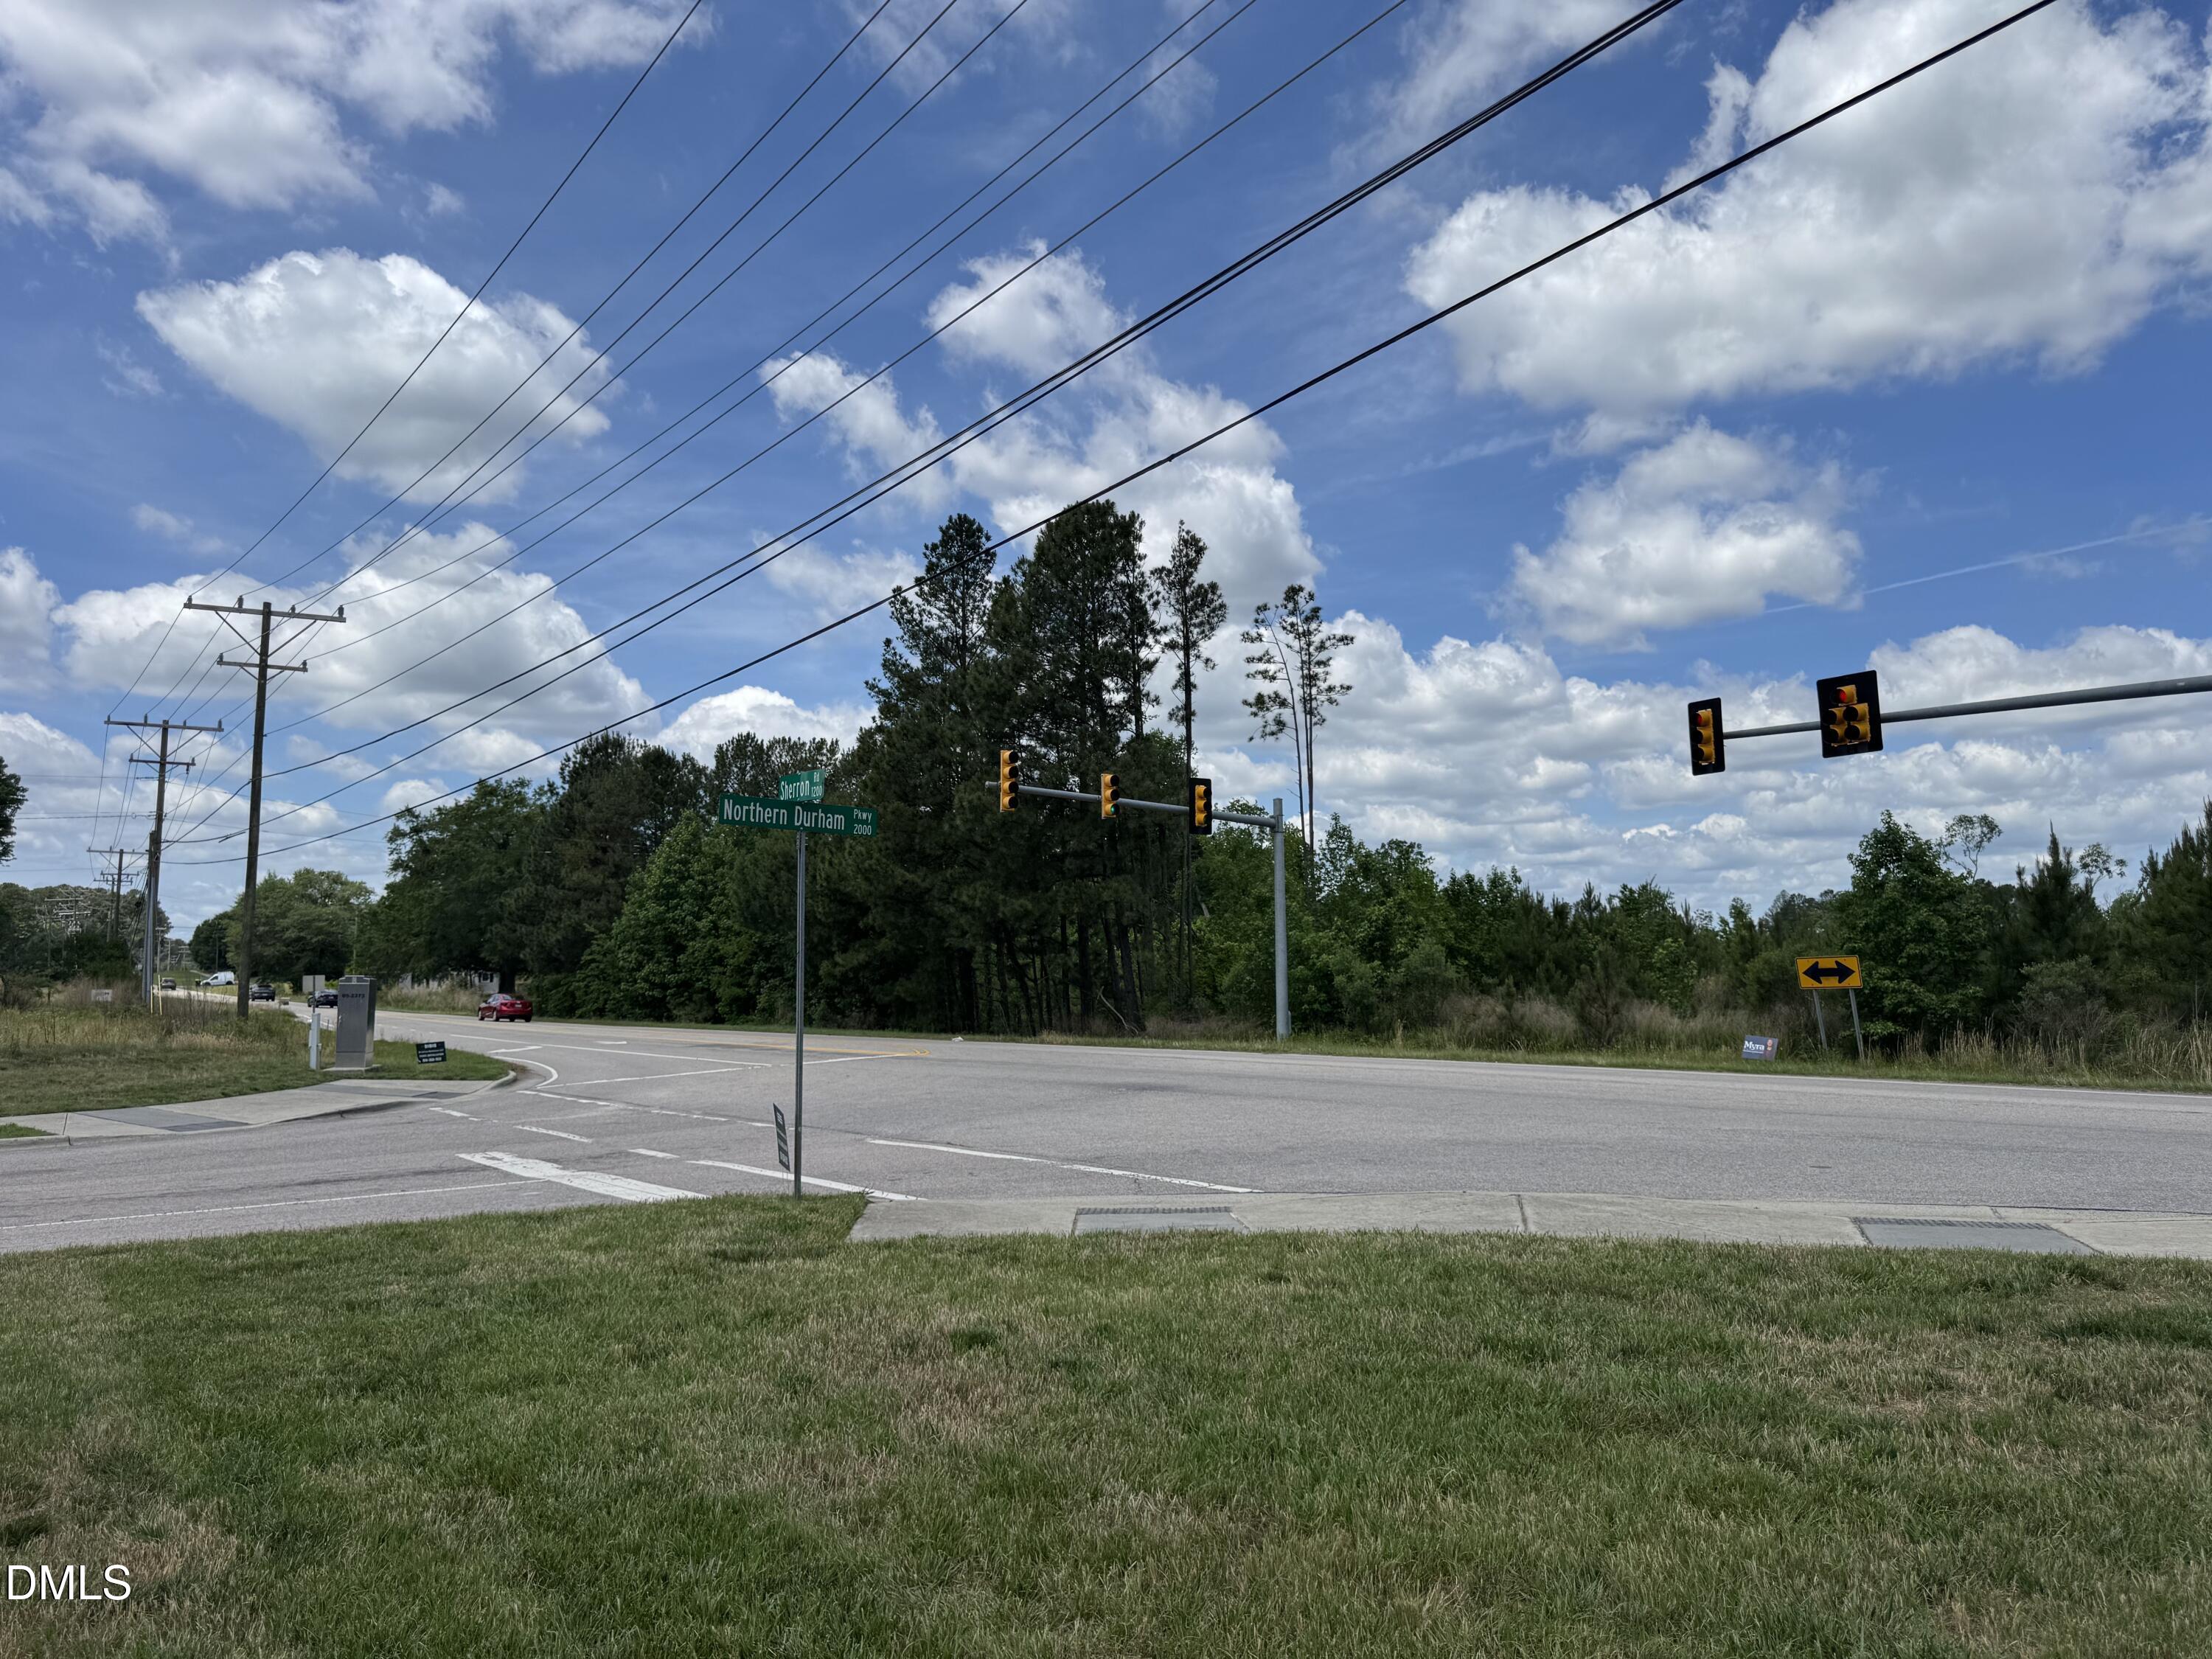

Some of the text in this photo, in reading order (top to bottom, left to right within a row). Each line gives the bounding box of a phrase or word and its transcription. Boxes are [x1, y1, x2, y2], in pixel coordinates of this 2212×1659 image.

[813, 772, 820, 783] Rd
[780, 779, 810, 800] Sherron
[811, 786, 822, 797] 1200
[723, 799, 845, 830] Northern Durham
[854, 809, 872, 823] Pkwy
[853, 824, 872, 835] 2000
[1744, 1040, 1764, 1051] Myra
